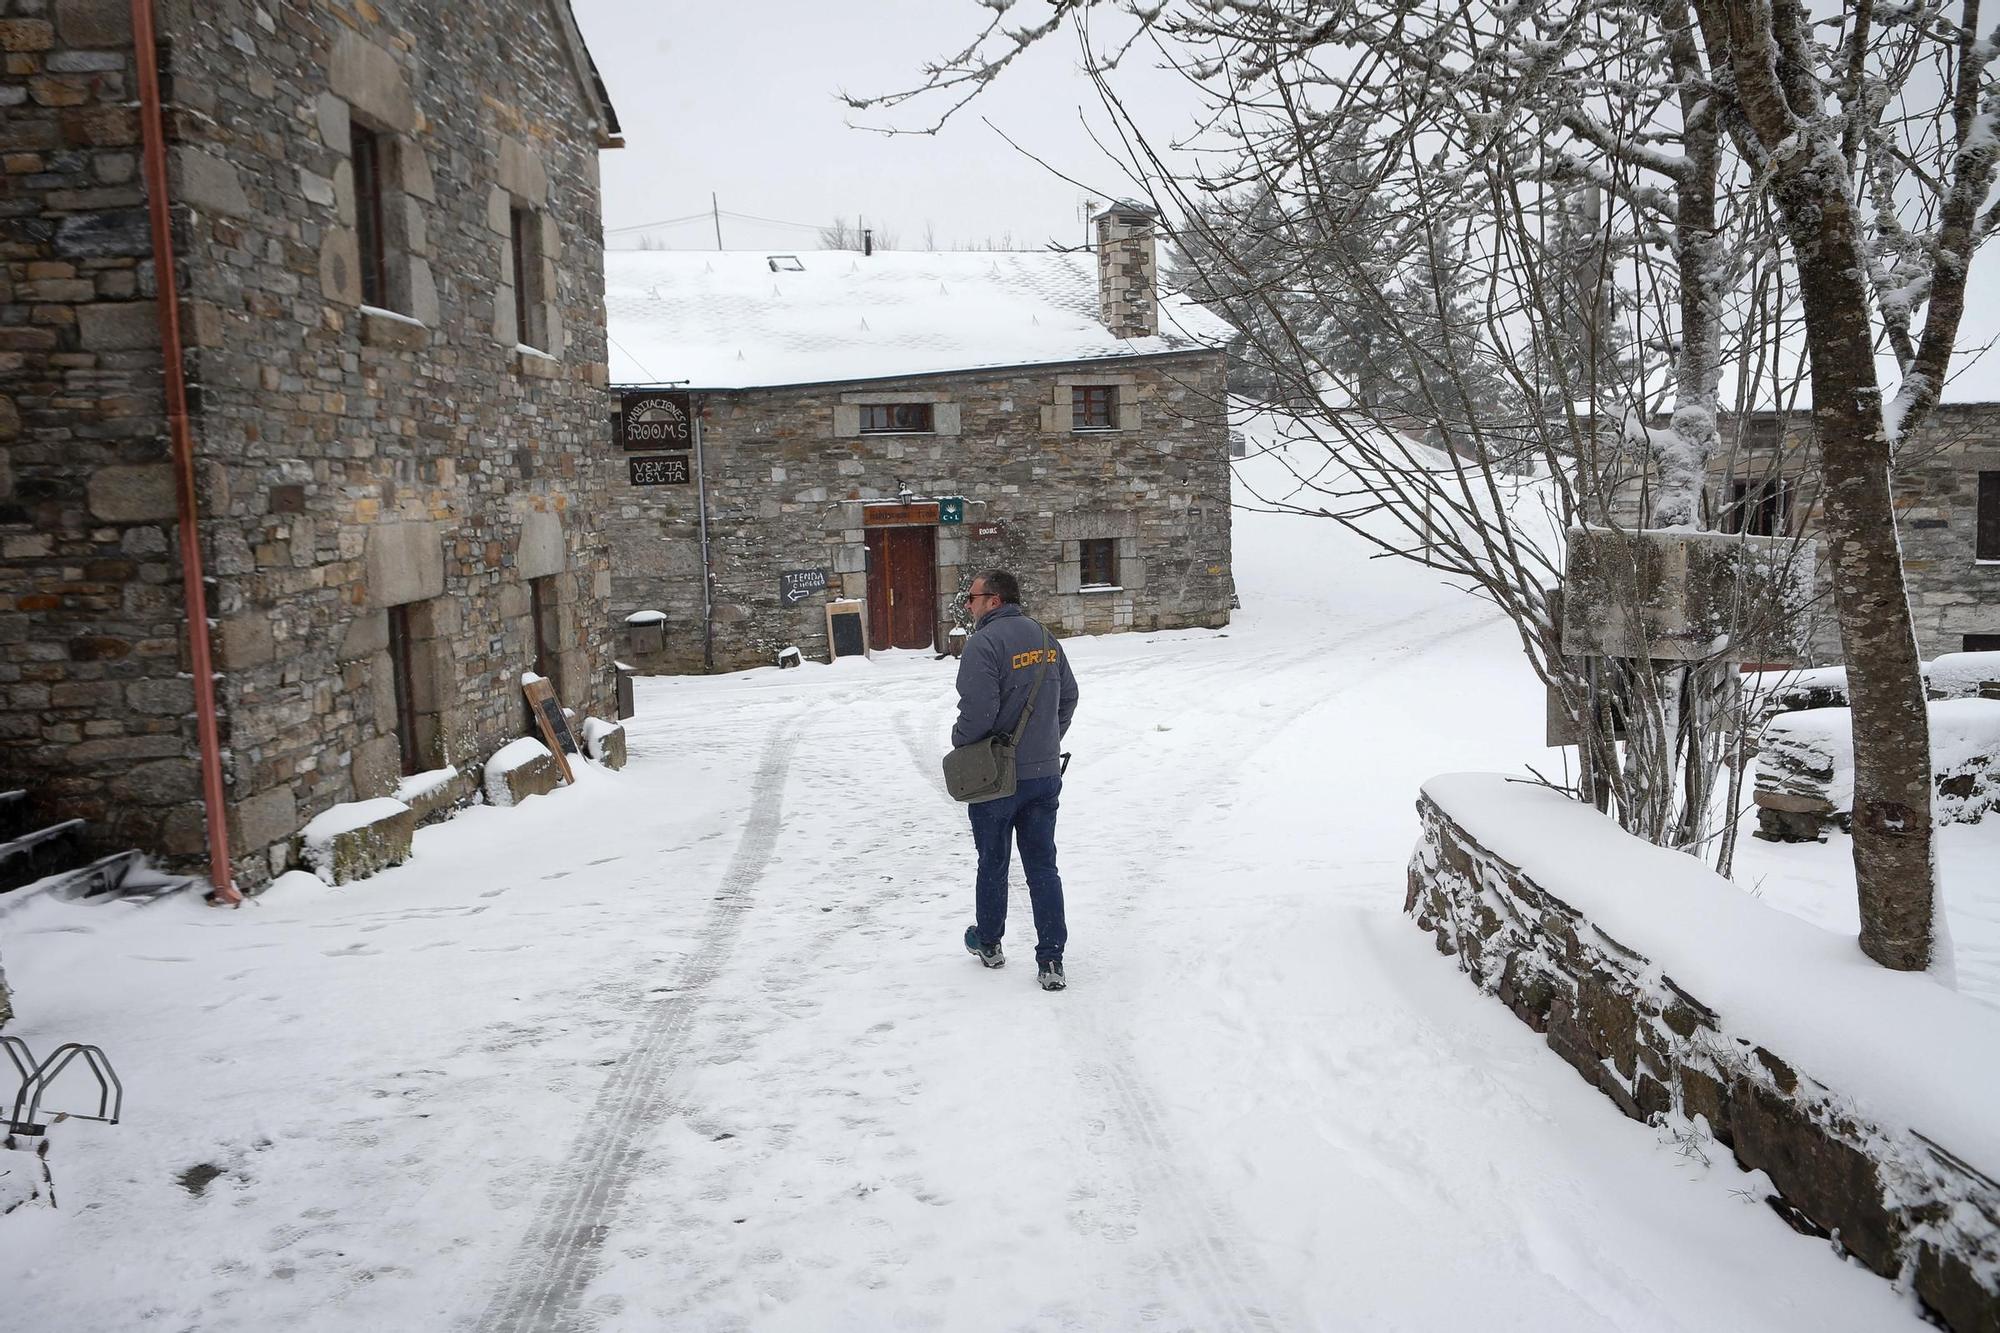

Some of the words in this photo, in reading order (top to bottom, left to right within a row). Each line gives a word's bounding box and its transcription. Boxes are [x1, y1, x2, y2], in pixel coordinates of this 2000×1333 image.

[626, 399, 687, 425] HABITACIONES
[627, 423, 688, 440] ROOMS
[633, 461, 686, 472] VENTA
[635, 471, 685, 483] CELTA
[785, 572, 824, 583] TIENDA
